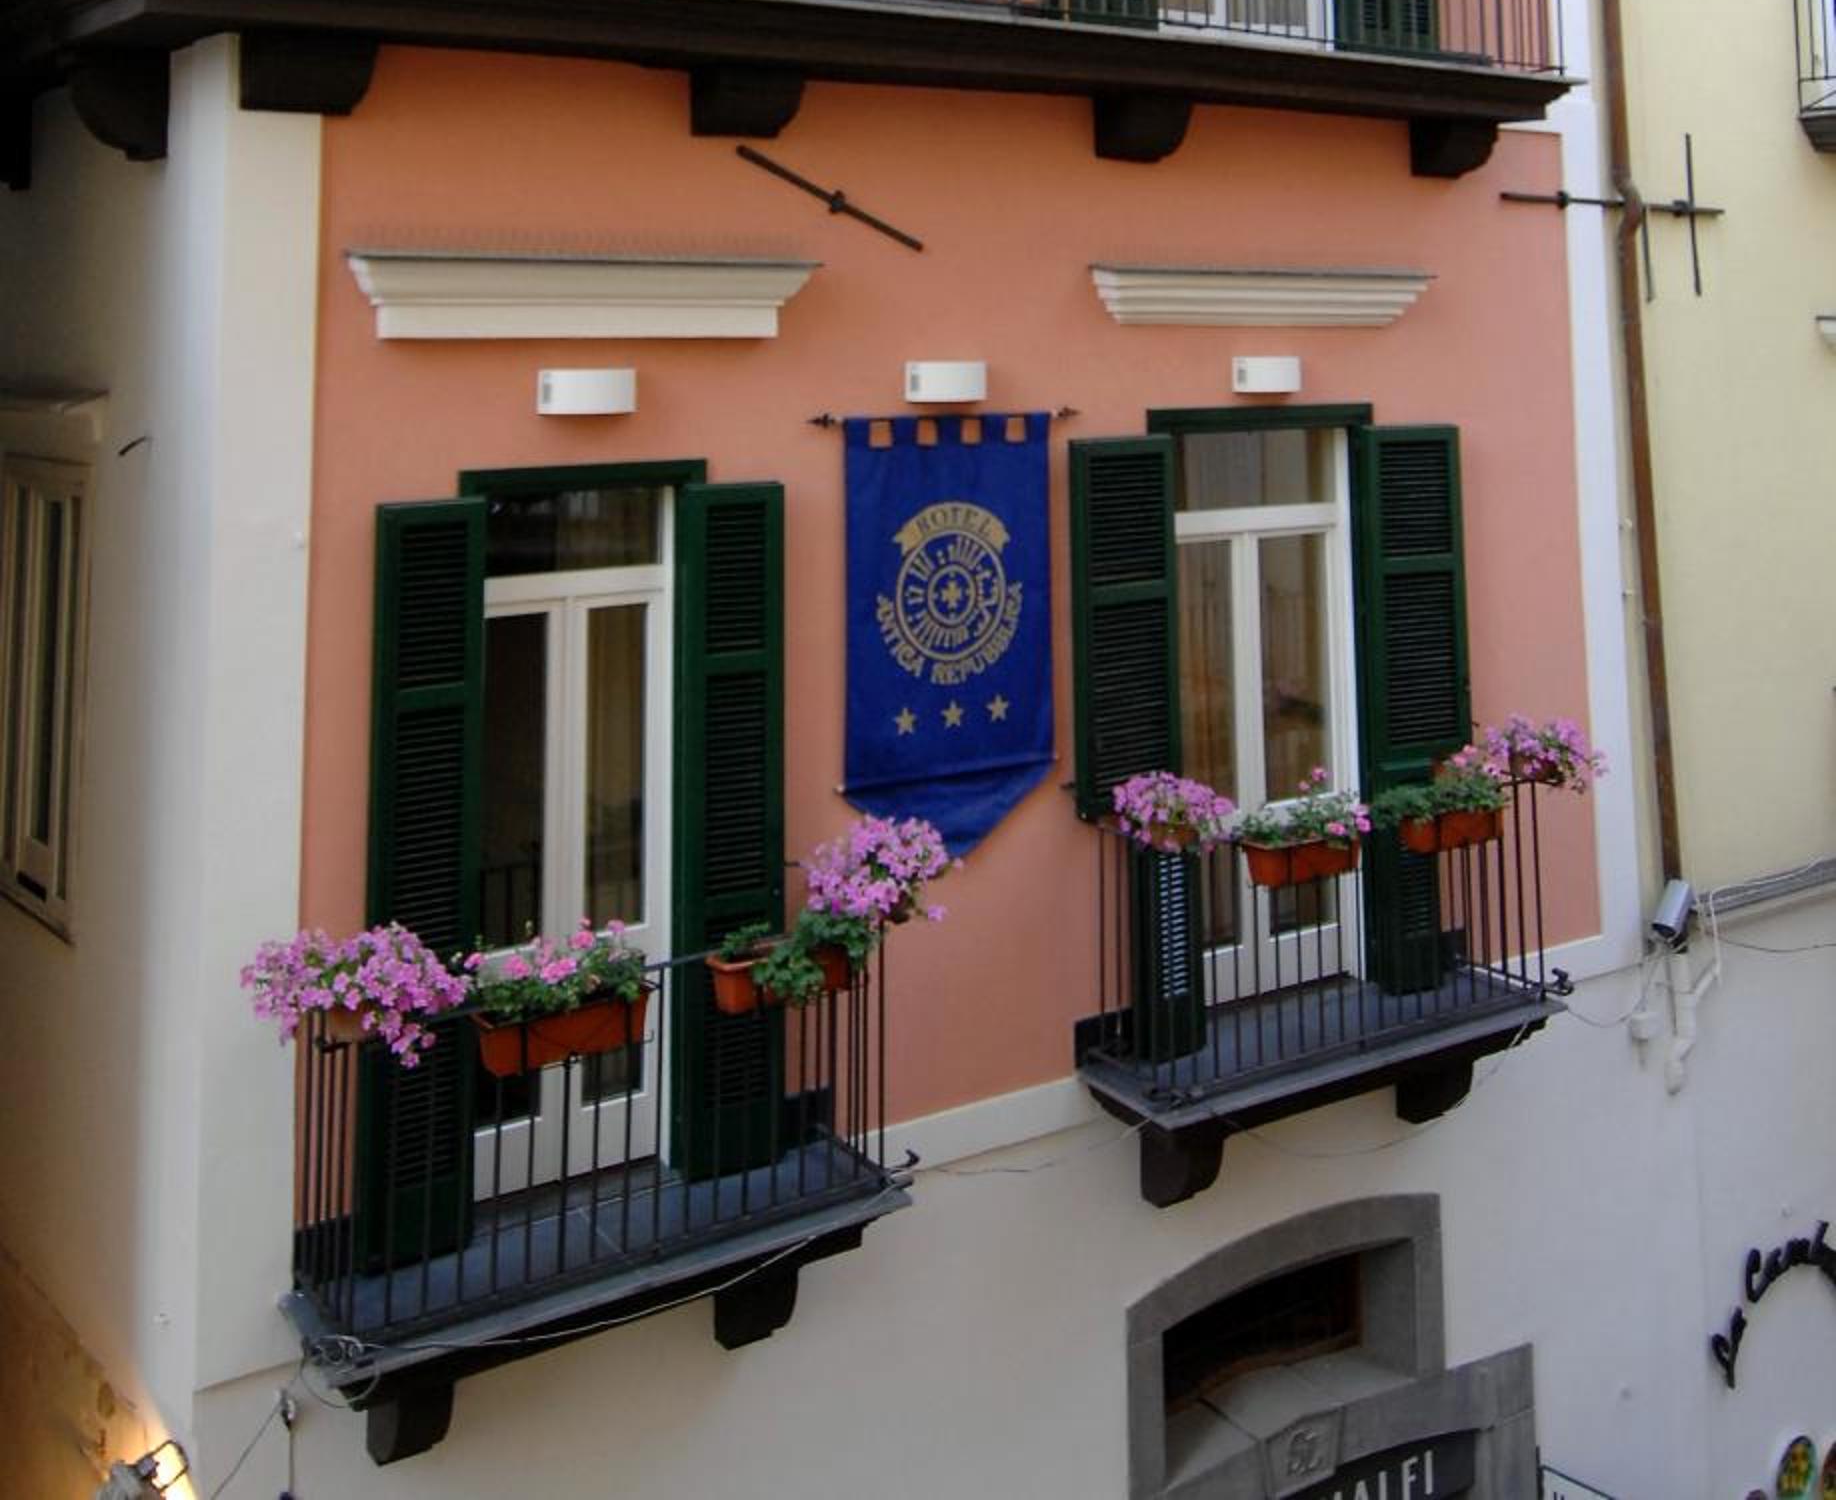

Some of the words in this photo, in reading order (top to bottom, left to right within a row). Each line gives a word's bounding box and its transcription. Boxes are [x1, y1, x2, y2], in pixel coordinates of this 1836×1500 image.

[915, 506, 993, 536] HOTEL
[876, 593, 925, 678] ANTICA
[930, 581, 1023, 686] REPUBBLICA
